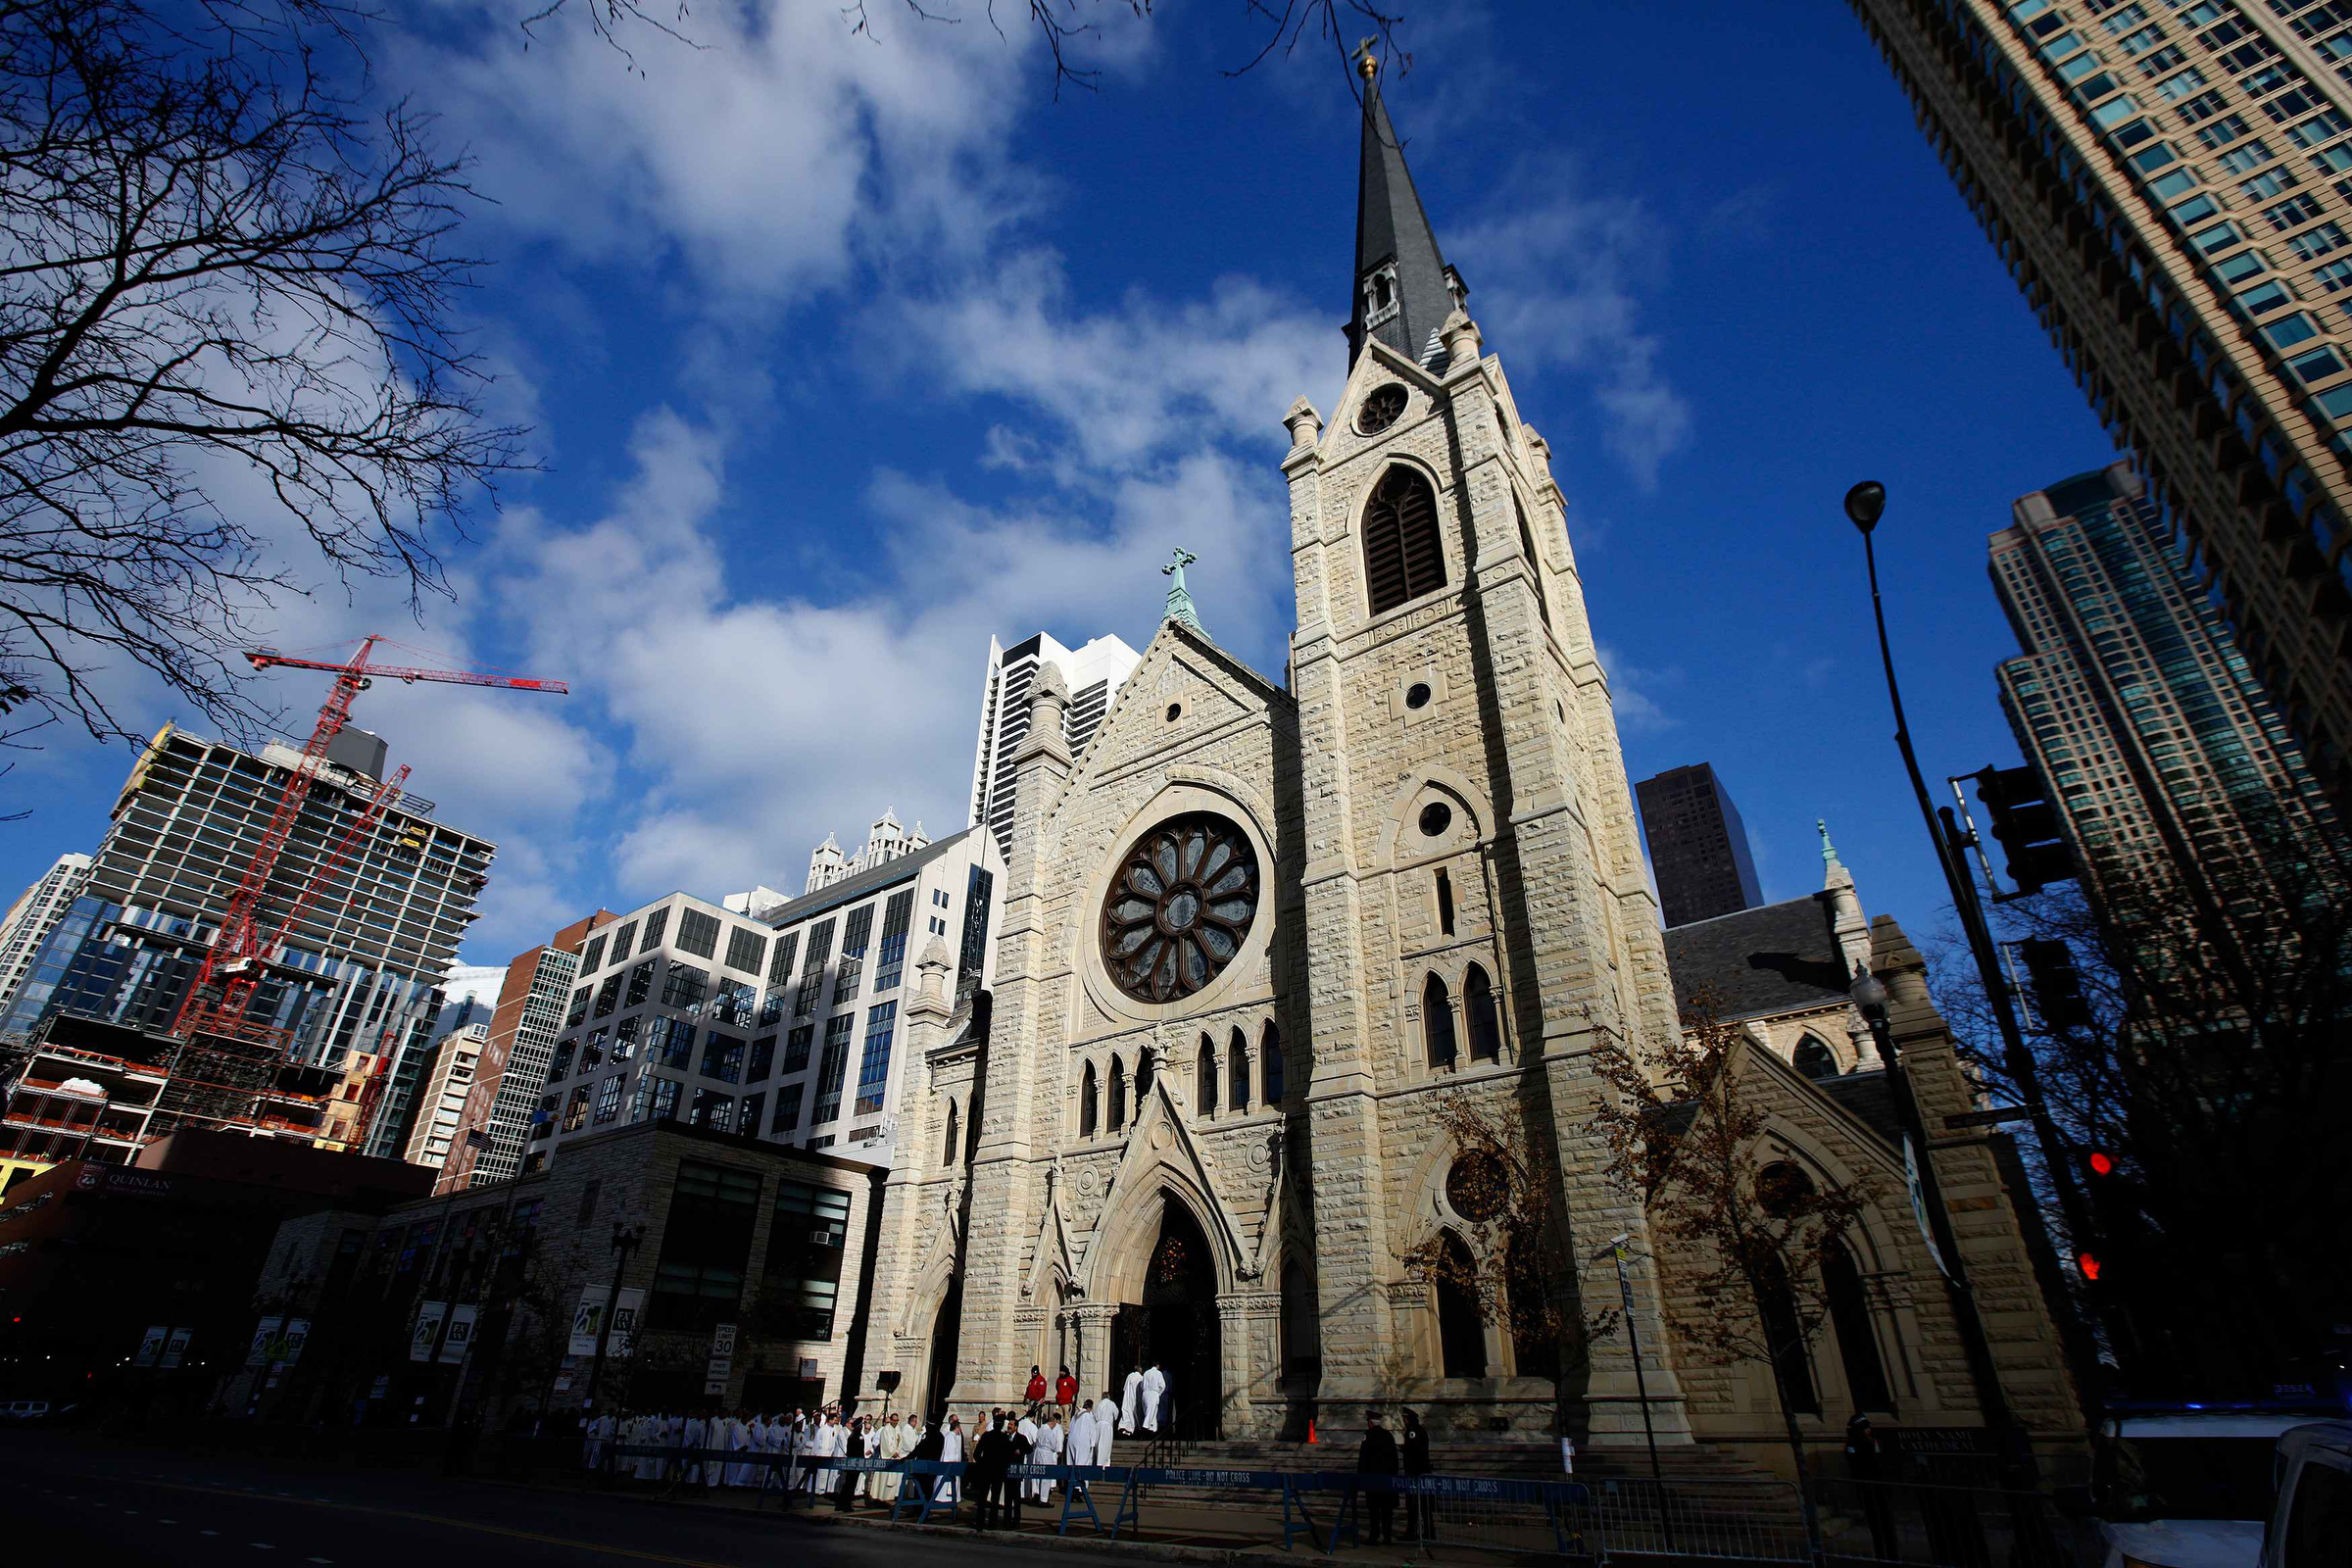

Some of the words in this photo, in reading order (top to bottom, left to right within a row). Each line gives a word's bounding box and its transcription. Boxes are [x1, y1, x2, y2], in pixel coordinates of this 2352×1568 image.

[109, 1173, 172, 1190] QUINLAN
[715, 1340, 732, 1352] 30
[1897, 1430, 1929, 1441] HOLY
[1935, 1430, 1975, 1441] NAME
[1898, 1441, 1977, 1451] CATHEDRAL
[1019, 1464, 1028, 1475] NOT
[1029, 1465, 1047, 1475] CROSS
[1165, 1469, 1185, 1481] POLICE
[1216, 1472, 1229, 1483] NOT
[1230, 1472, 1250, 1484] CROSS
[1392, 1477, 1418, 1489] POLICE
[1455, 1480, 1471, 1492] NOT
